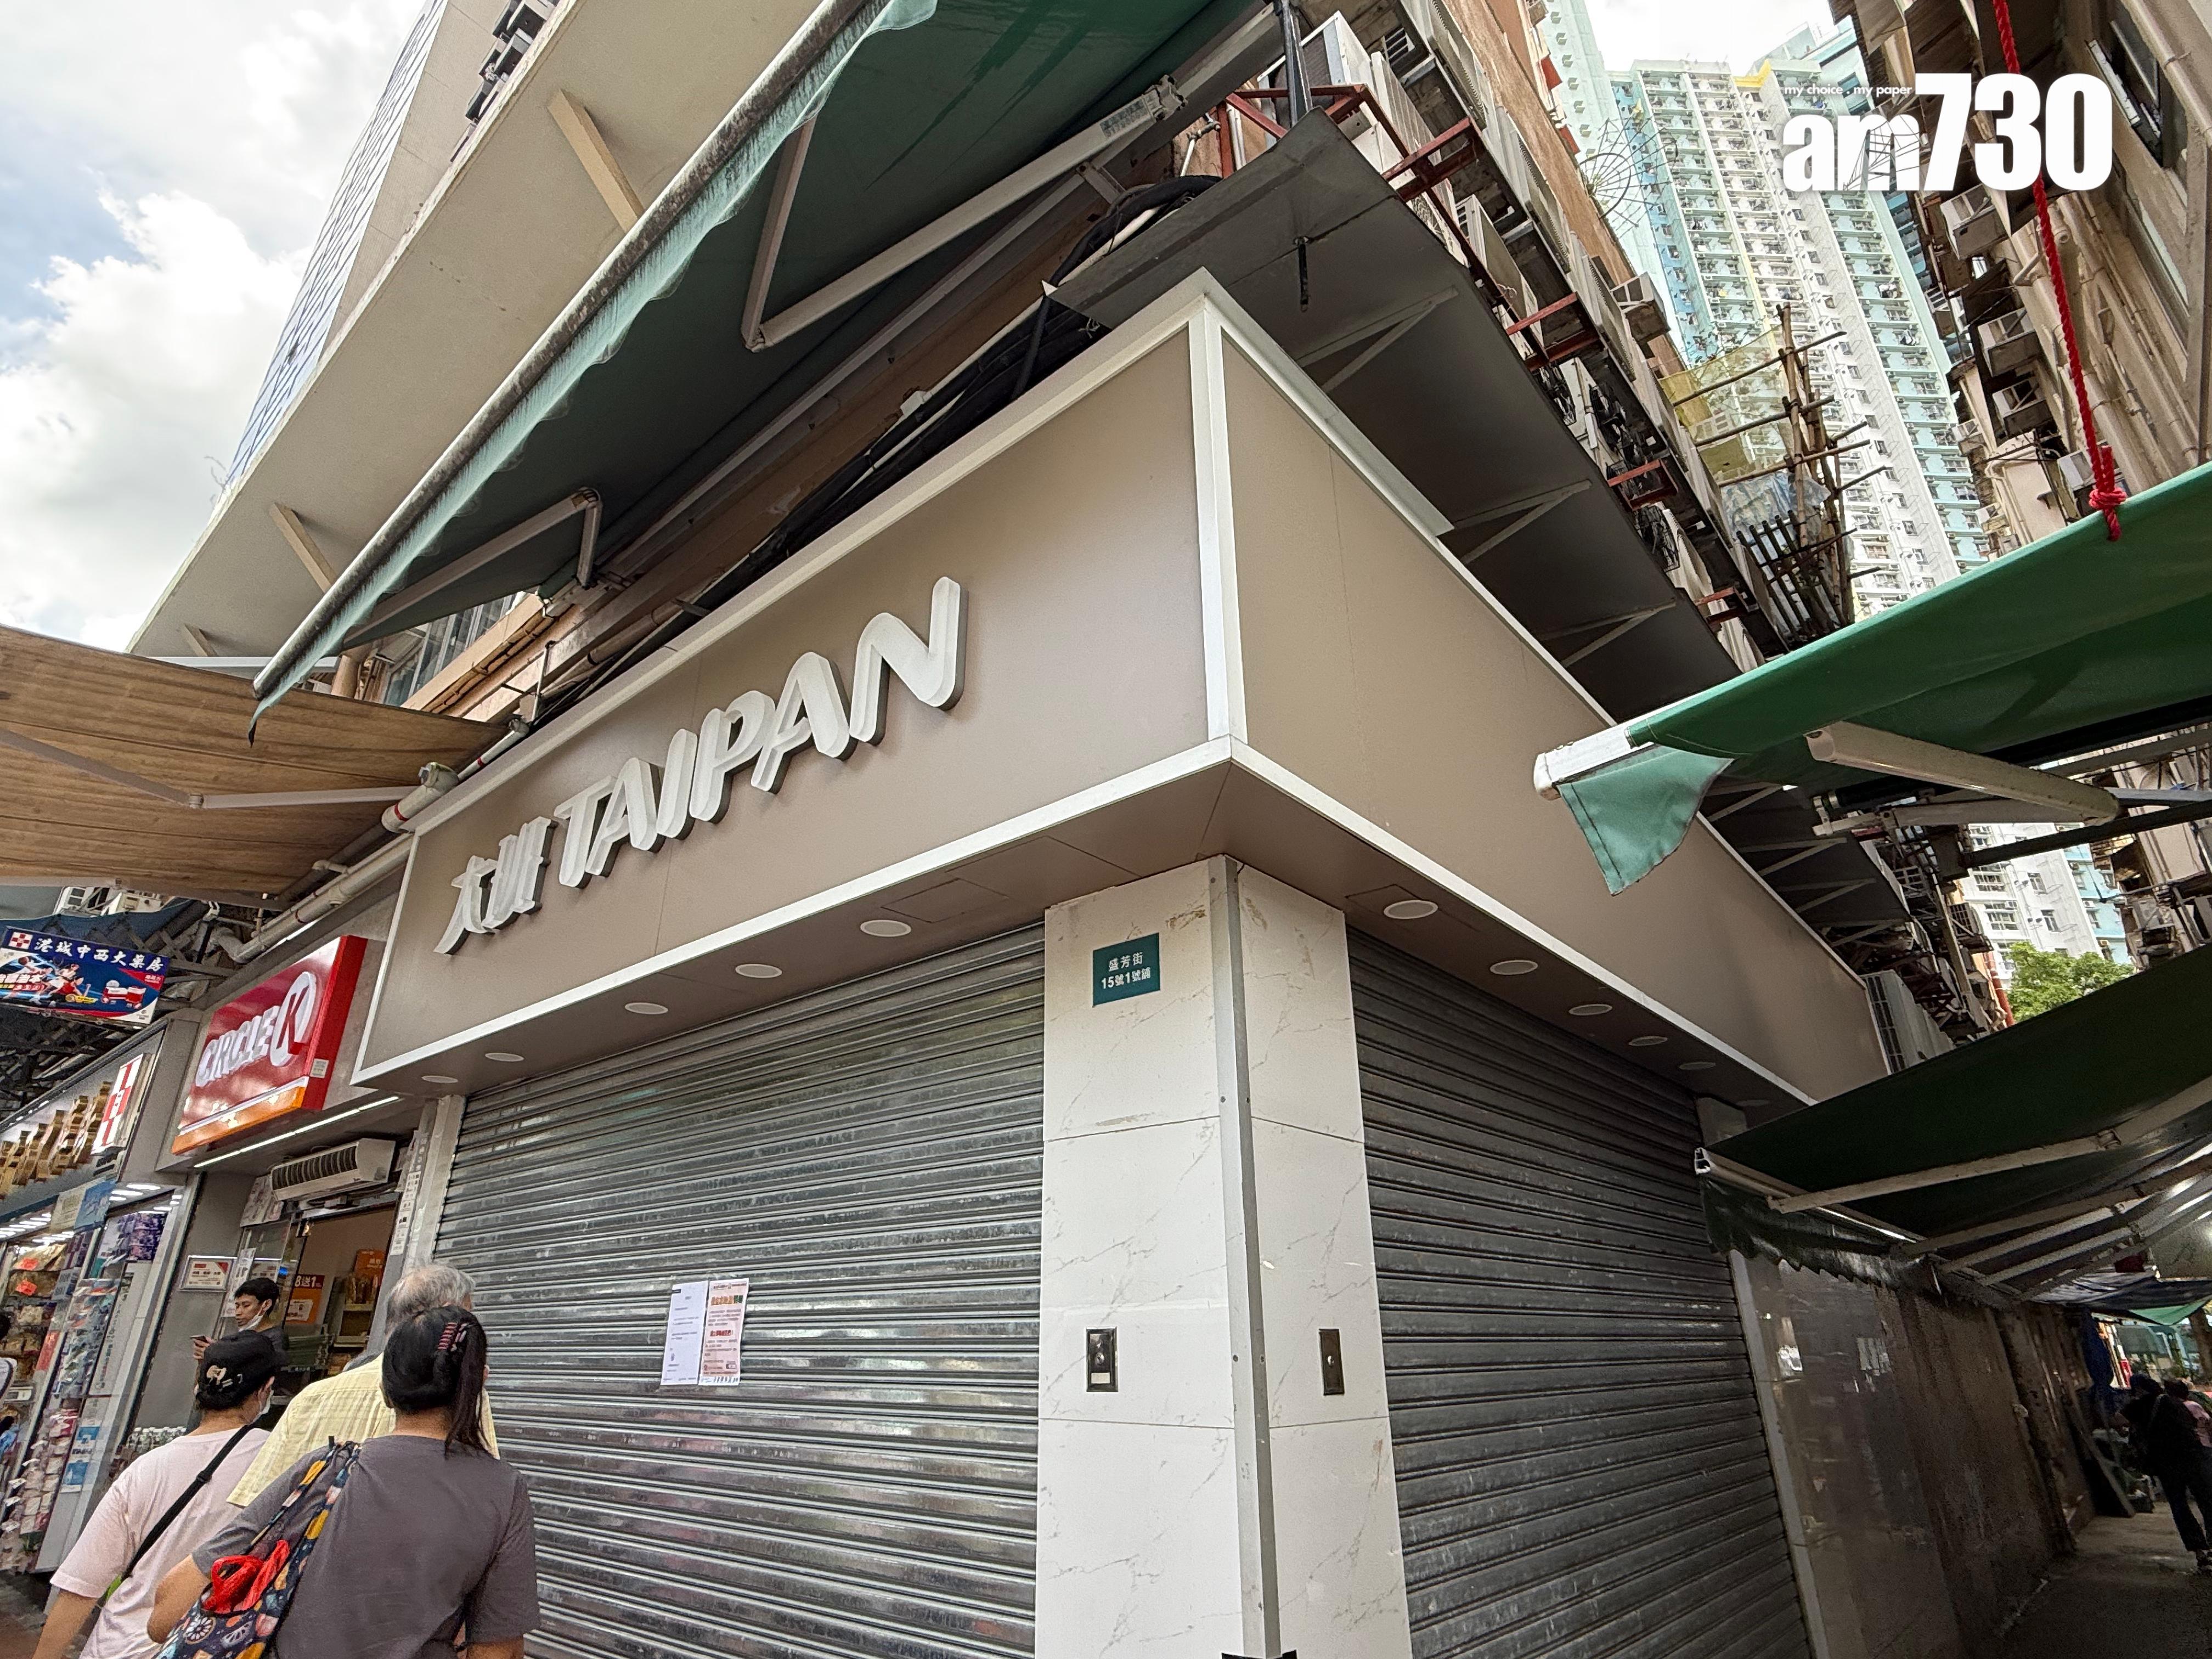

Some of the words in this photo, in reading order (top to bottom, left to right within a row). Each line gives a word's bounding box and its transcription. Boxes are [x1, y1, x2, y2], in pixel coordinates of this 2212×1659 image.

[554, 576, 964, 889] TAIPAN
[1108, 952, 1143, 972] 盛芳街
[195, 1005, 281, 1088] CIRCLE
[273, 979, 313, 1059] K
